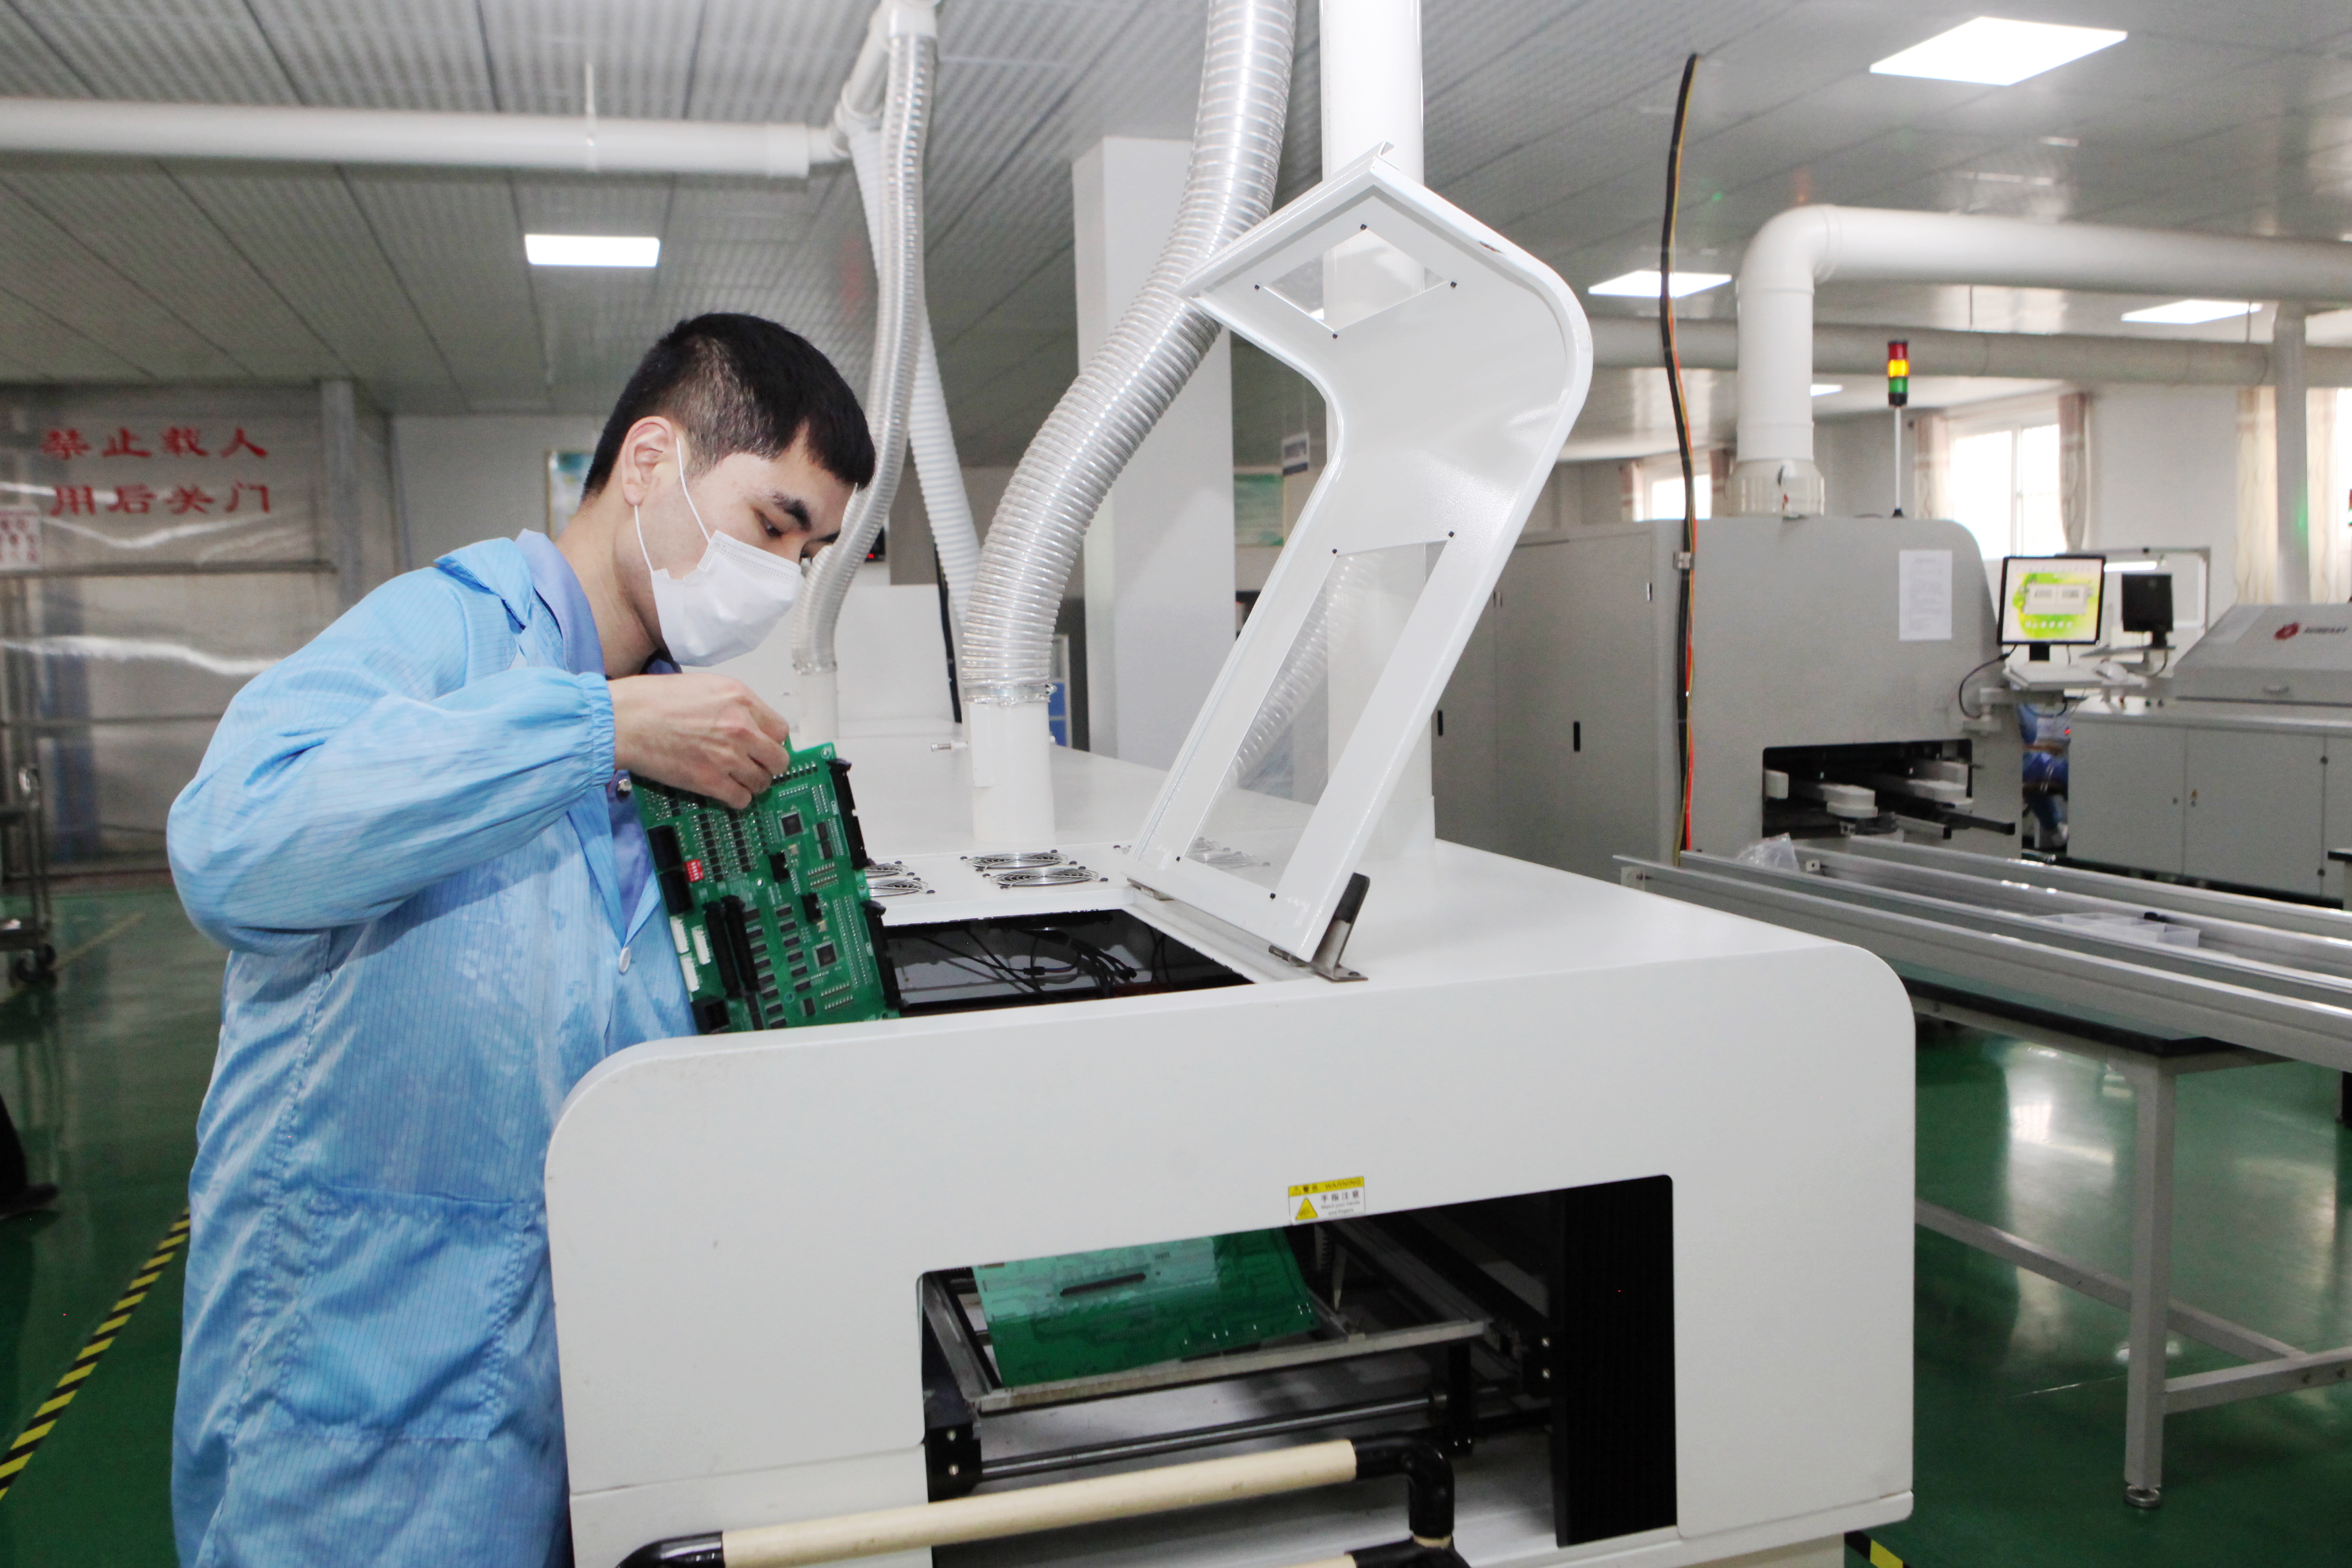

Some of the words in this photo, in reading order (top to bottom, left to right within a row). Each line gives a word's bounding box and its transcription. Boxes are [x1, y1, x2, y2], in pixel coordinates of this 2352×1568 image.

[41, 427, 268, 460] 禁止载人
[49, 482, 270, 517] 用后关门
[1325, 1180, 1361, 1188] WARNING
